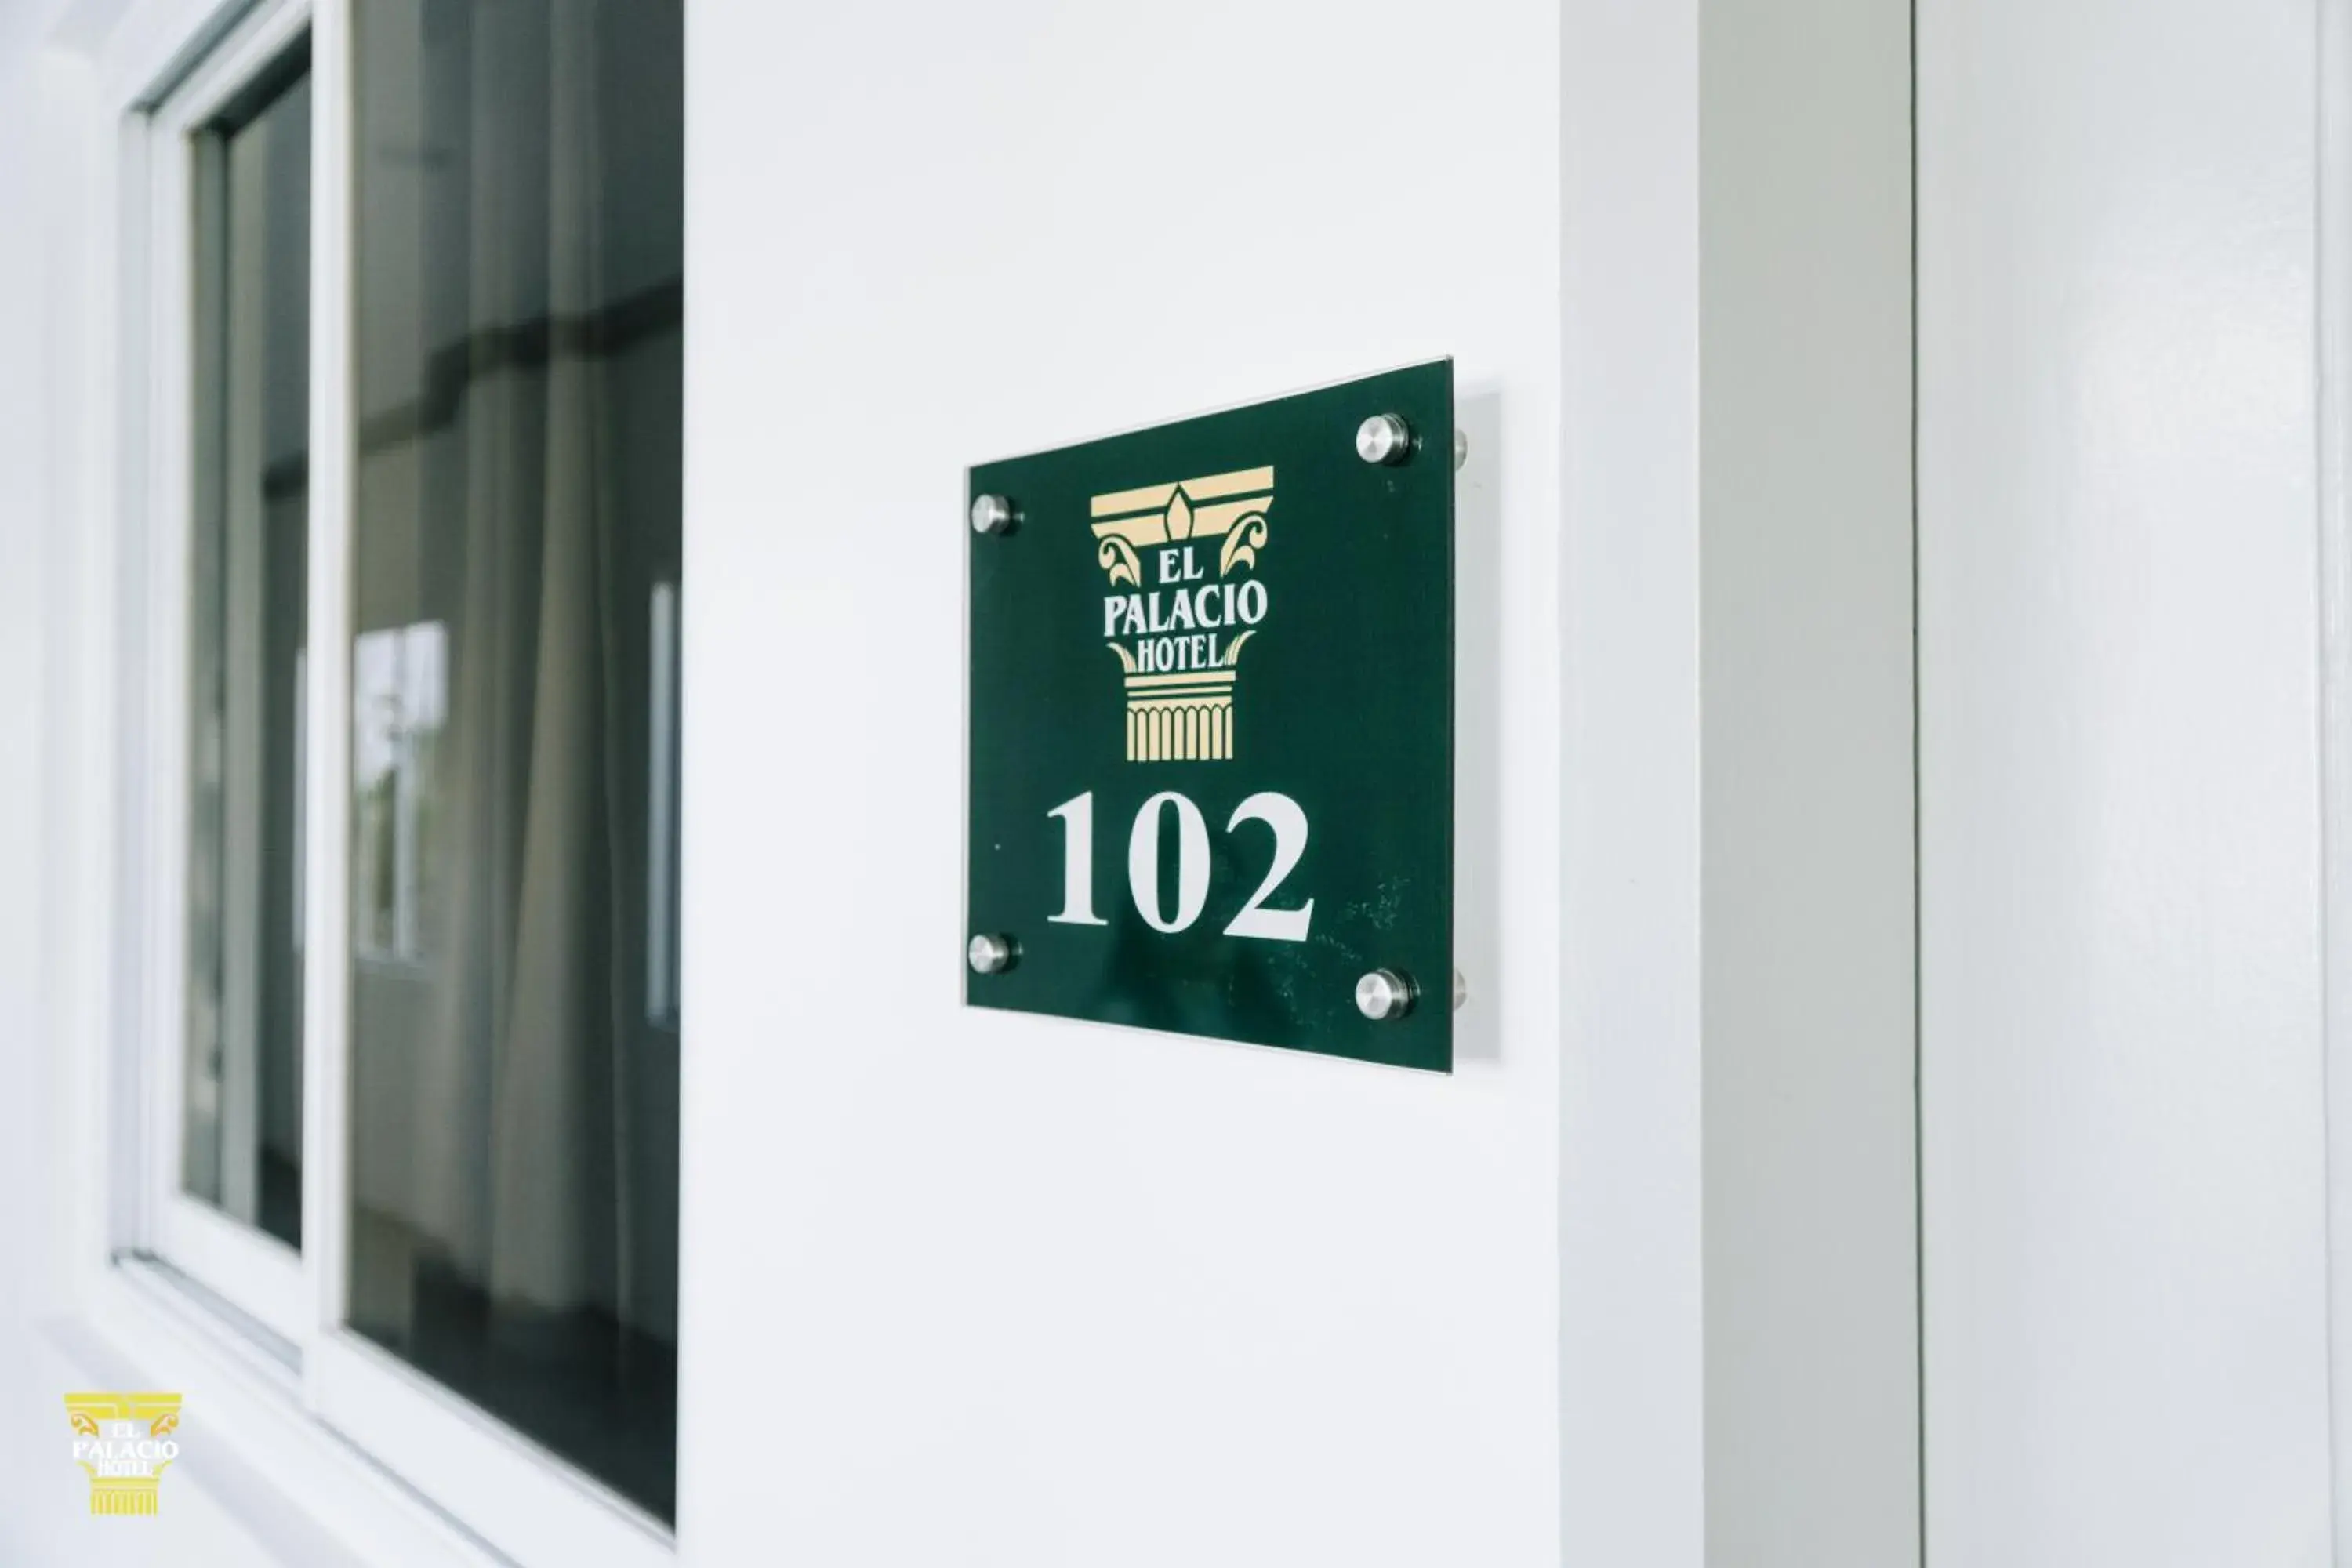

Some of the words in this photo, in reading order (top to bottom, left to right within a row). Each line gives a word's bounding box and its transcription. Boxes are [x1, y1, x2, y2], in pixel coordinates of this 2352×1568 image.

[1159, 546, 1203, 583] EL
[1104, 579, 1268, 637] PALACIO
[1137, 633, 1224, 672] HOTEL
[1047, 790, 1315, 942] 102
